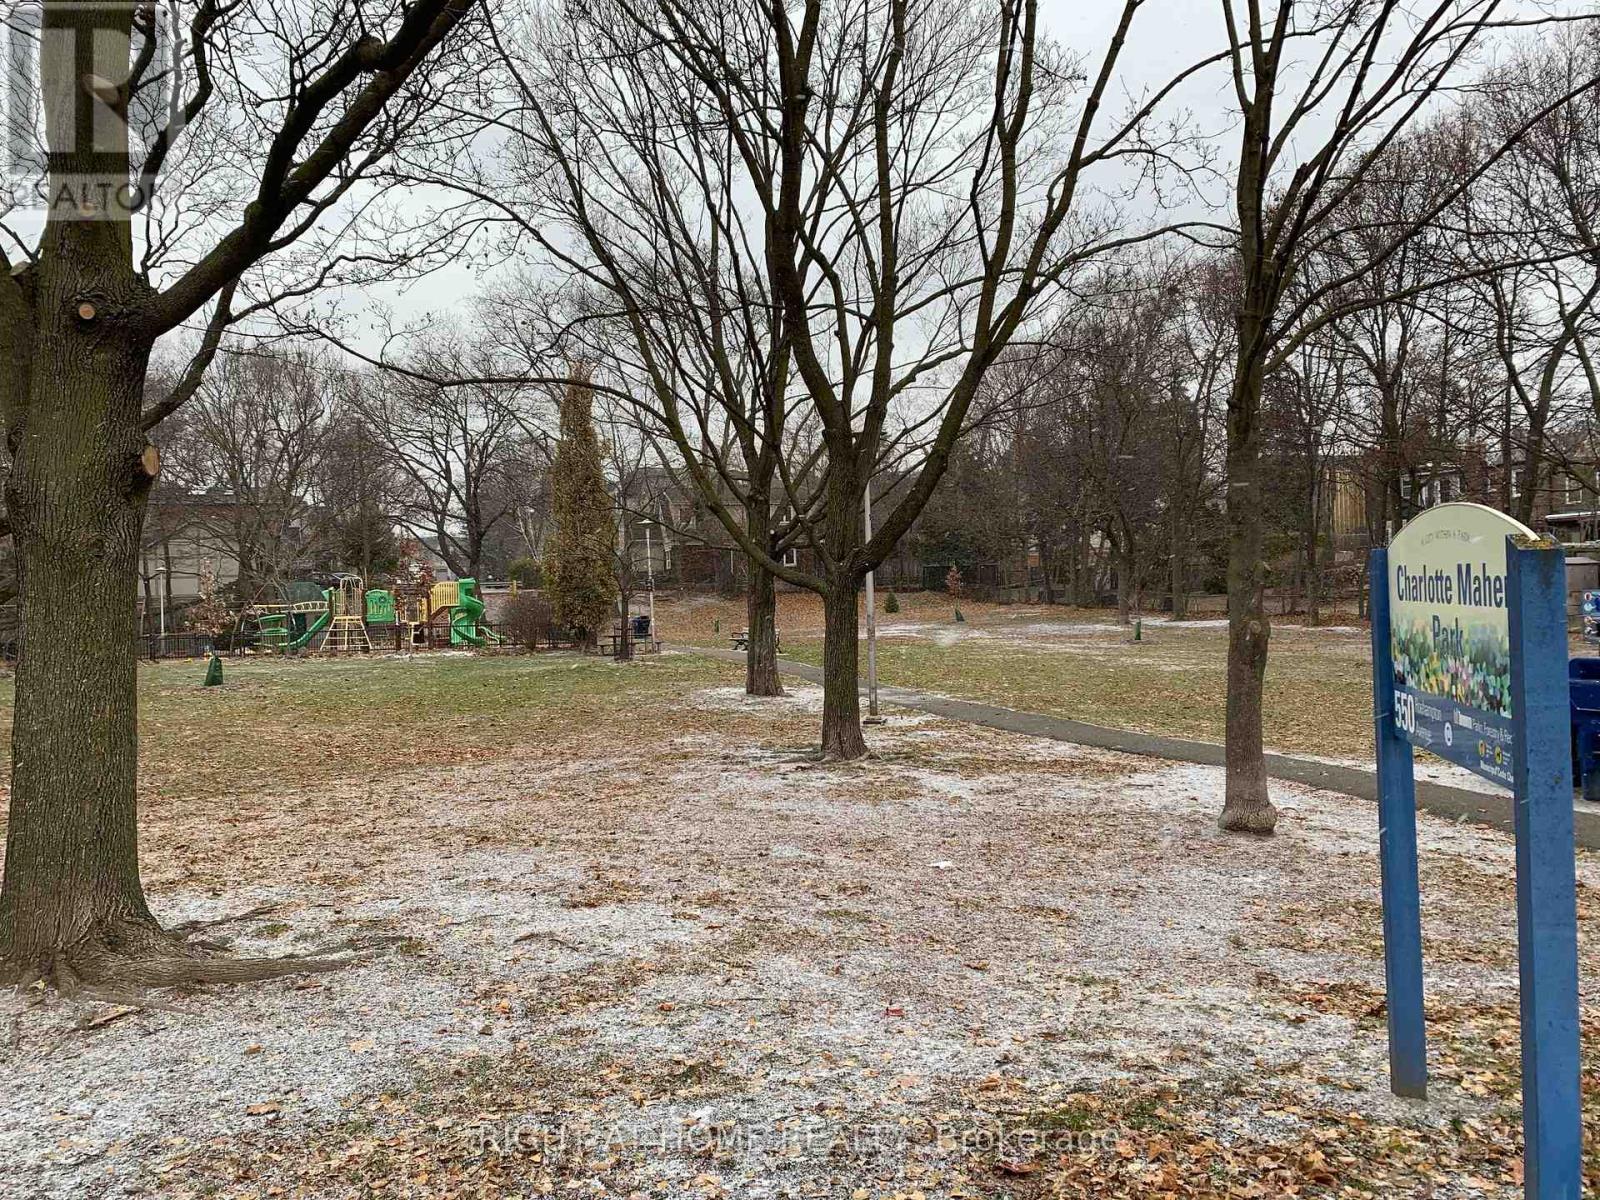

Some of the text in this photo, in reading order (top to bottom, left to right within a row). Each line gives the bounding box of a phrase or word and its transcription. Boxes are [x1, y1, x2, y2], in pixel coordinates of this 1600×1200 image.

[1396, 564, 1453, 605] Charlotte
[1432, 614, 1465, 658] Park
[1394, 690, 1416, 734] 550
